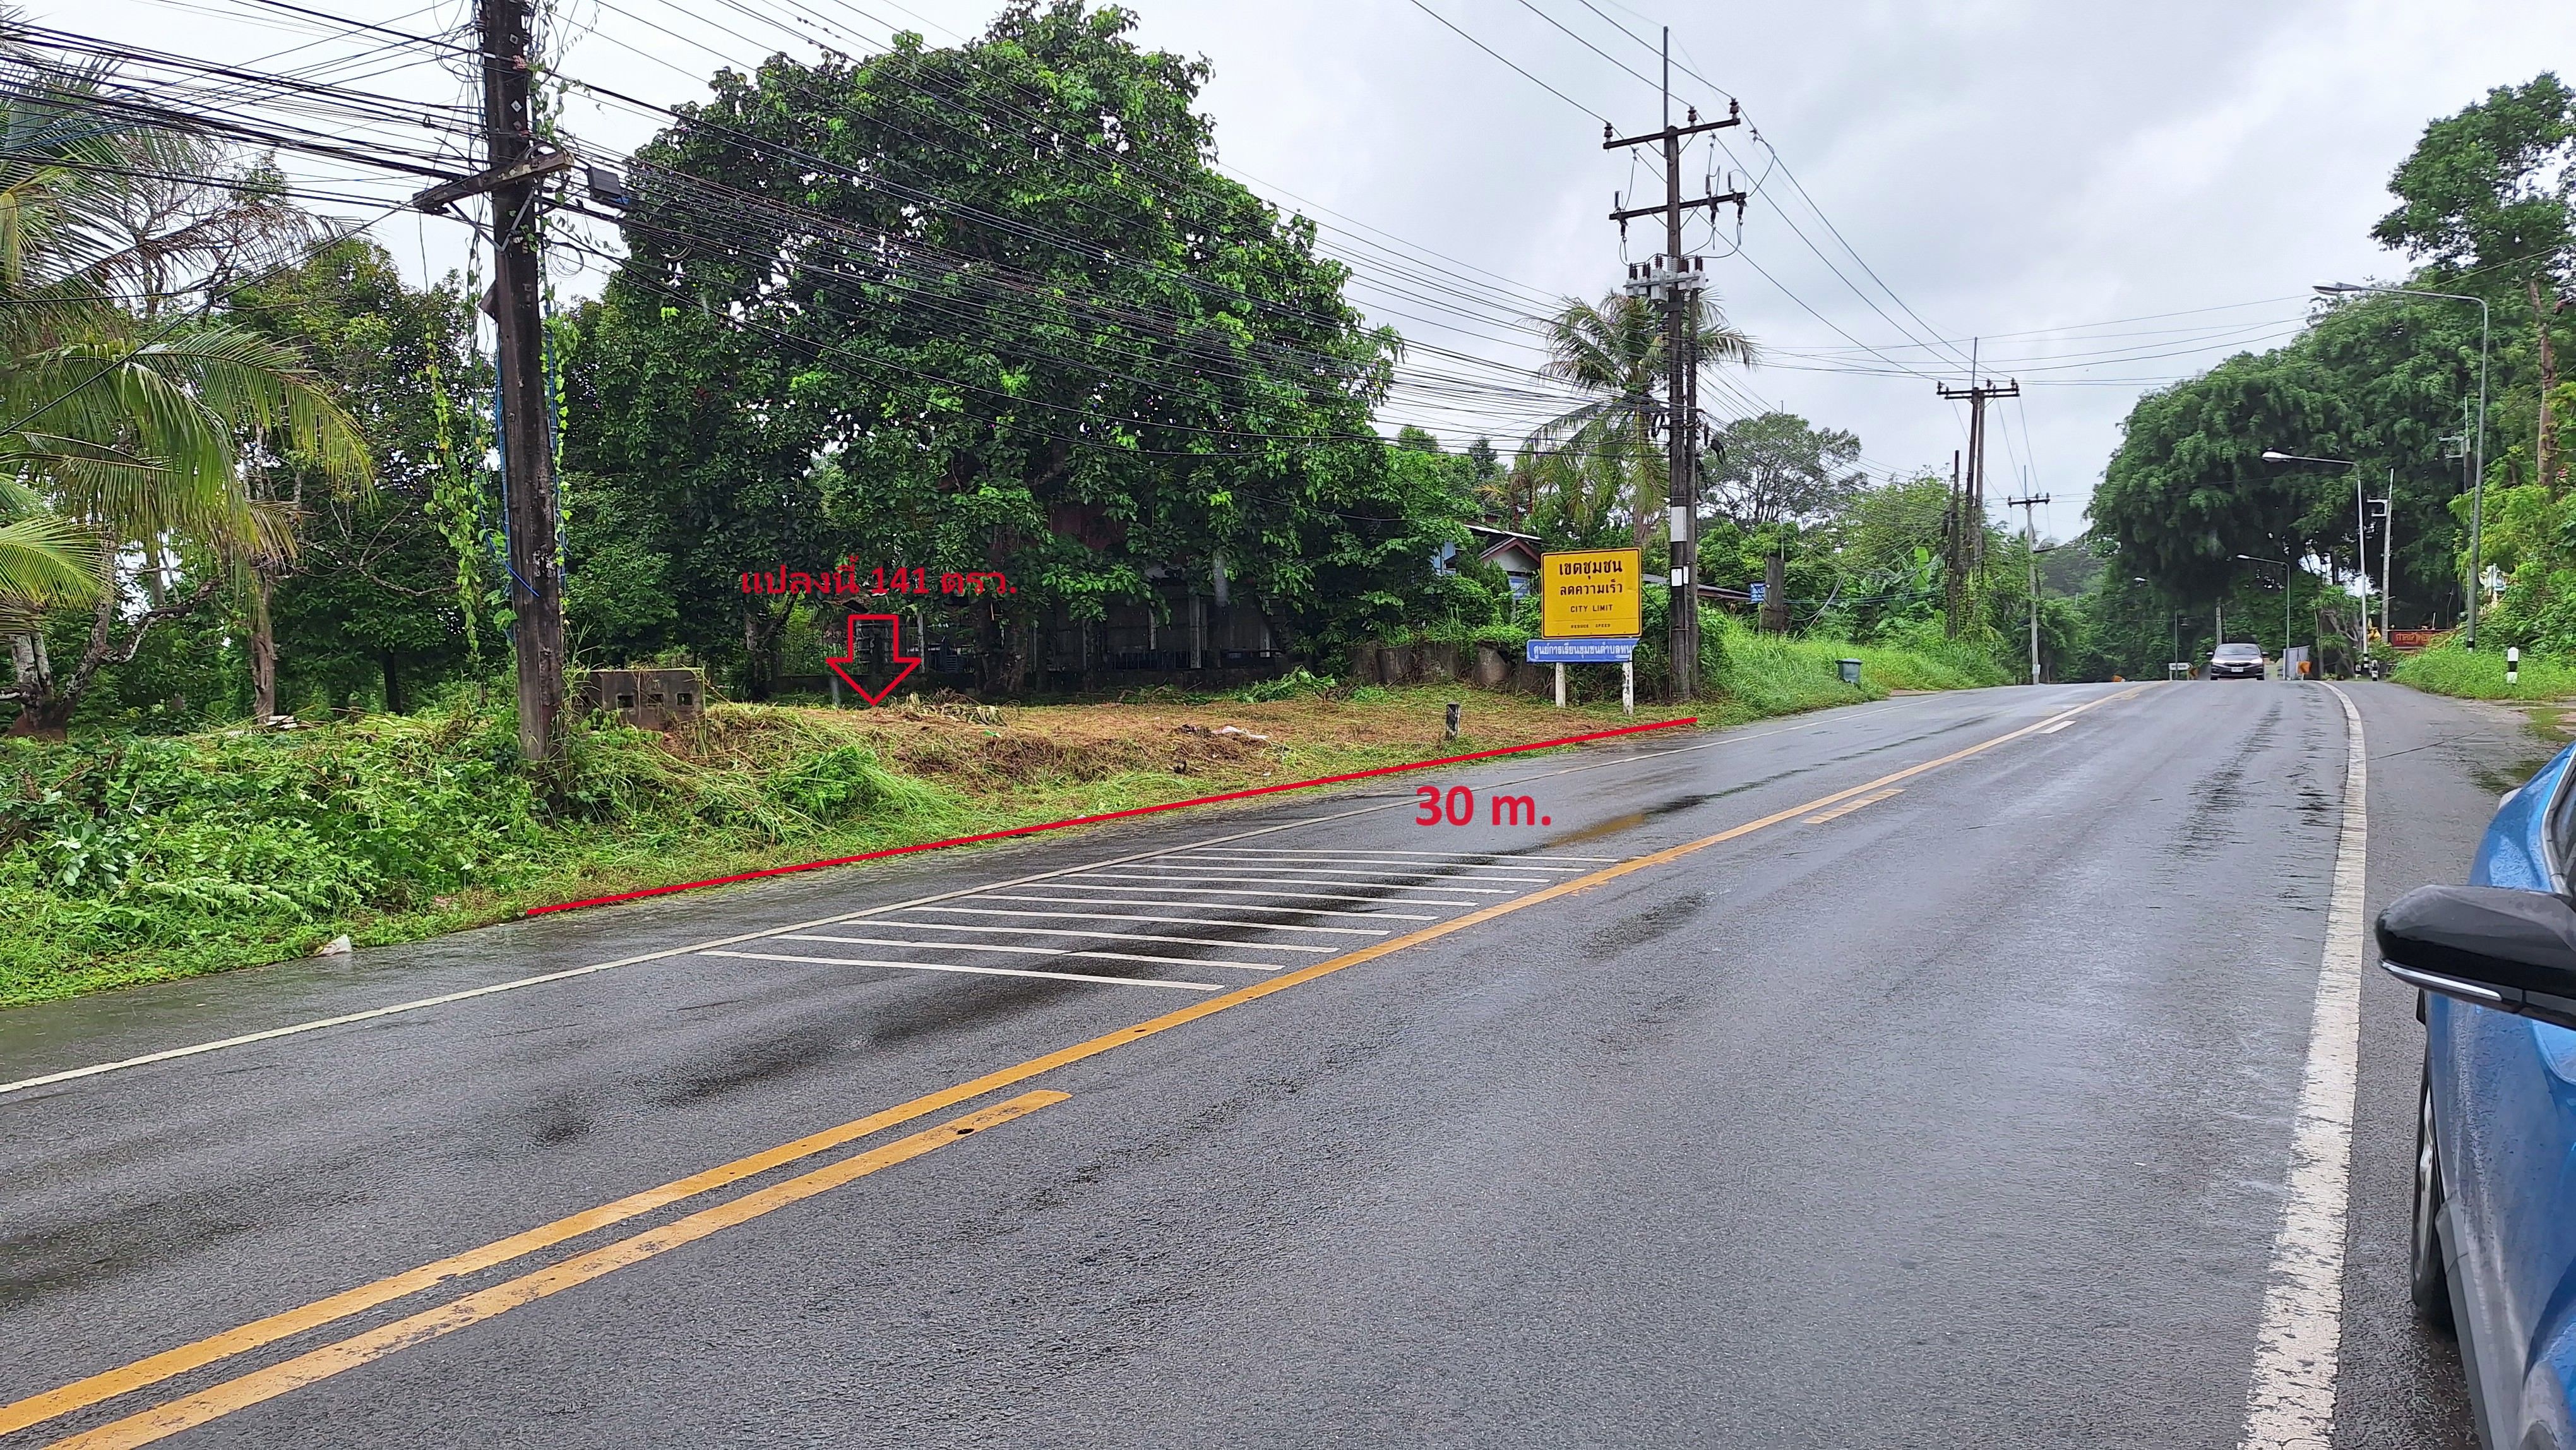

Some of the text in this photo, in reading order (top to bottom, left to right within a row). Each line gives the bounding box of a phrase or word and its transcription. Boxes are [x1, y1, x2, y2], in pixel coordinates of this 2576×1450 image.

[1559, 560, 1623, 580] เขตชุมชน
[1560, 578, 1623, 596] ลดความเร็ว
[1592, 604, 1613, 612] LIMIT
